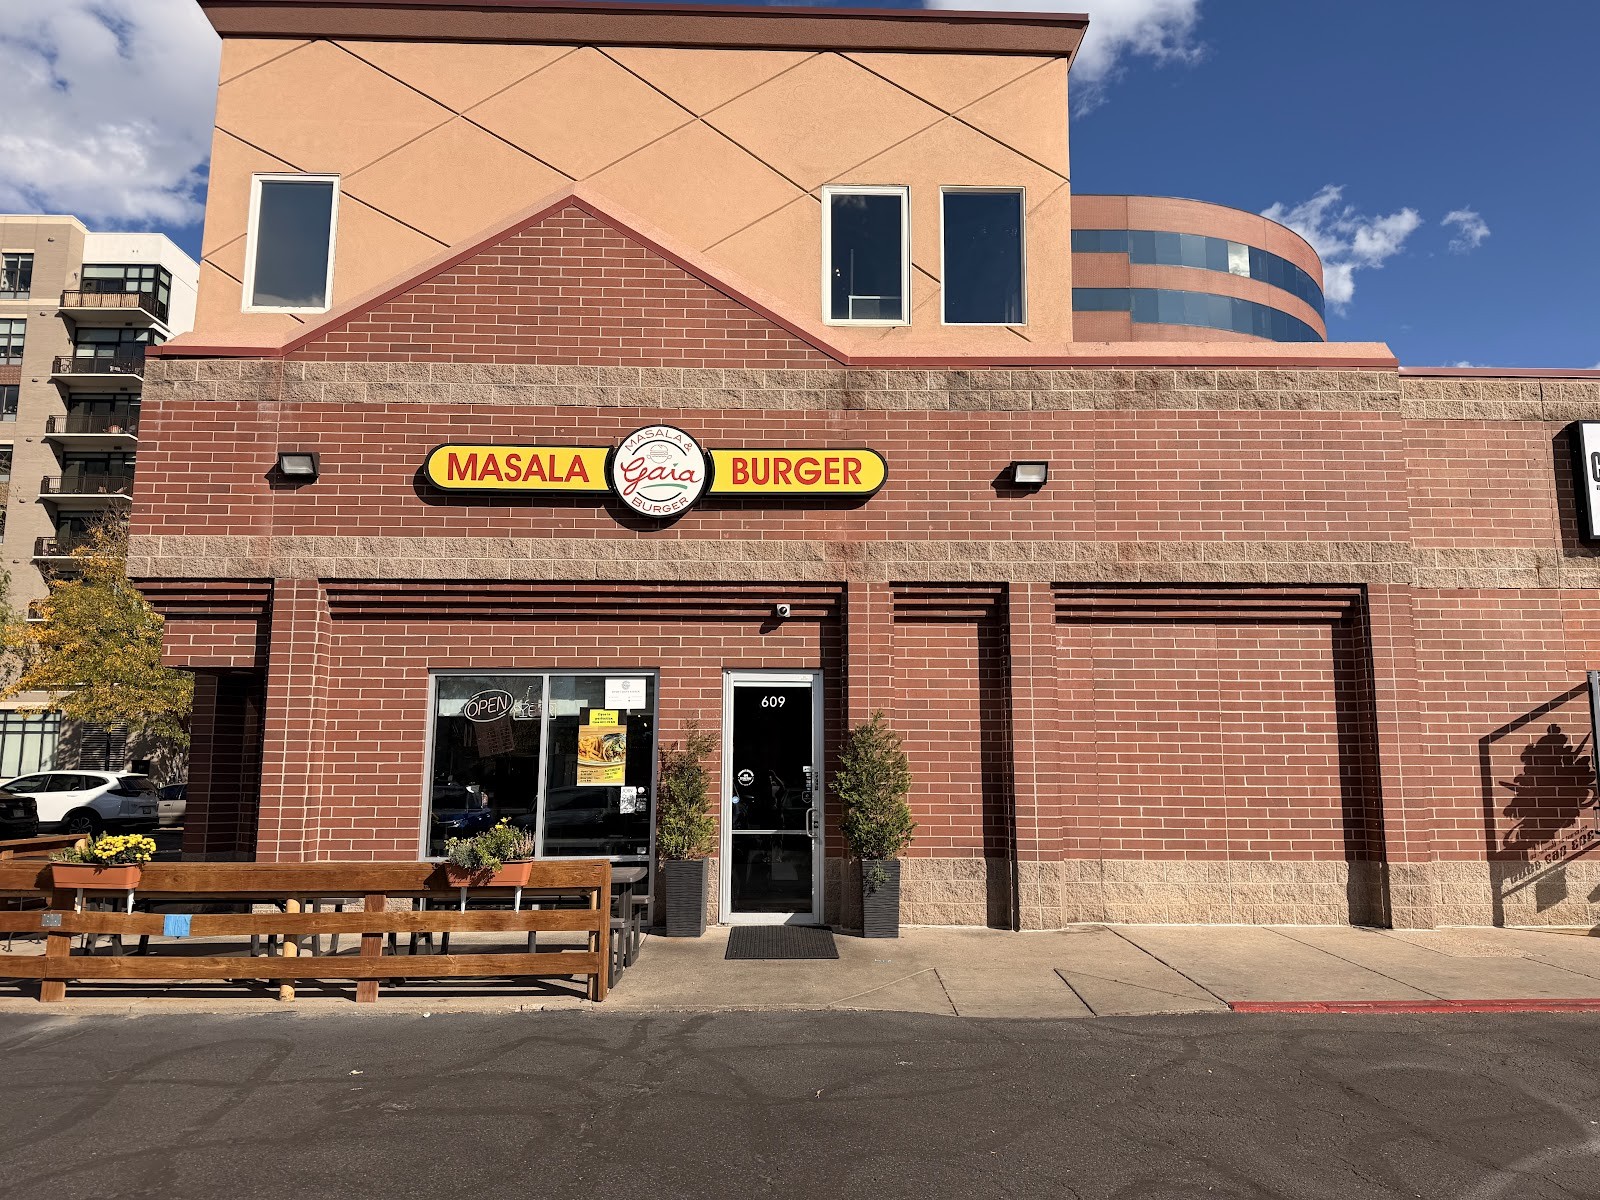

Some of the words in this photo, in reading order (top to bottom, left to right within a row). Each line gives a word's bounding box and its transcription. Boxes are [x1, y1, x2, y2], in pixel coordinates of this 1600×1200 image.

[625, 429, 682, 451] MASALA
[683, 442, 693, 452] &
[447, 453, 590, 483] MASALA
[620, 457, 702, 496] Gaia
[732, 457, 862, 485] BURGER
[631, 497, 689, 513] BURGER
[467, 695, 508, 717] OPEN
[761, 696, 786, 708] 609
